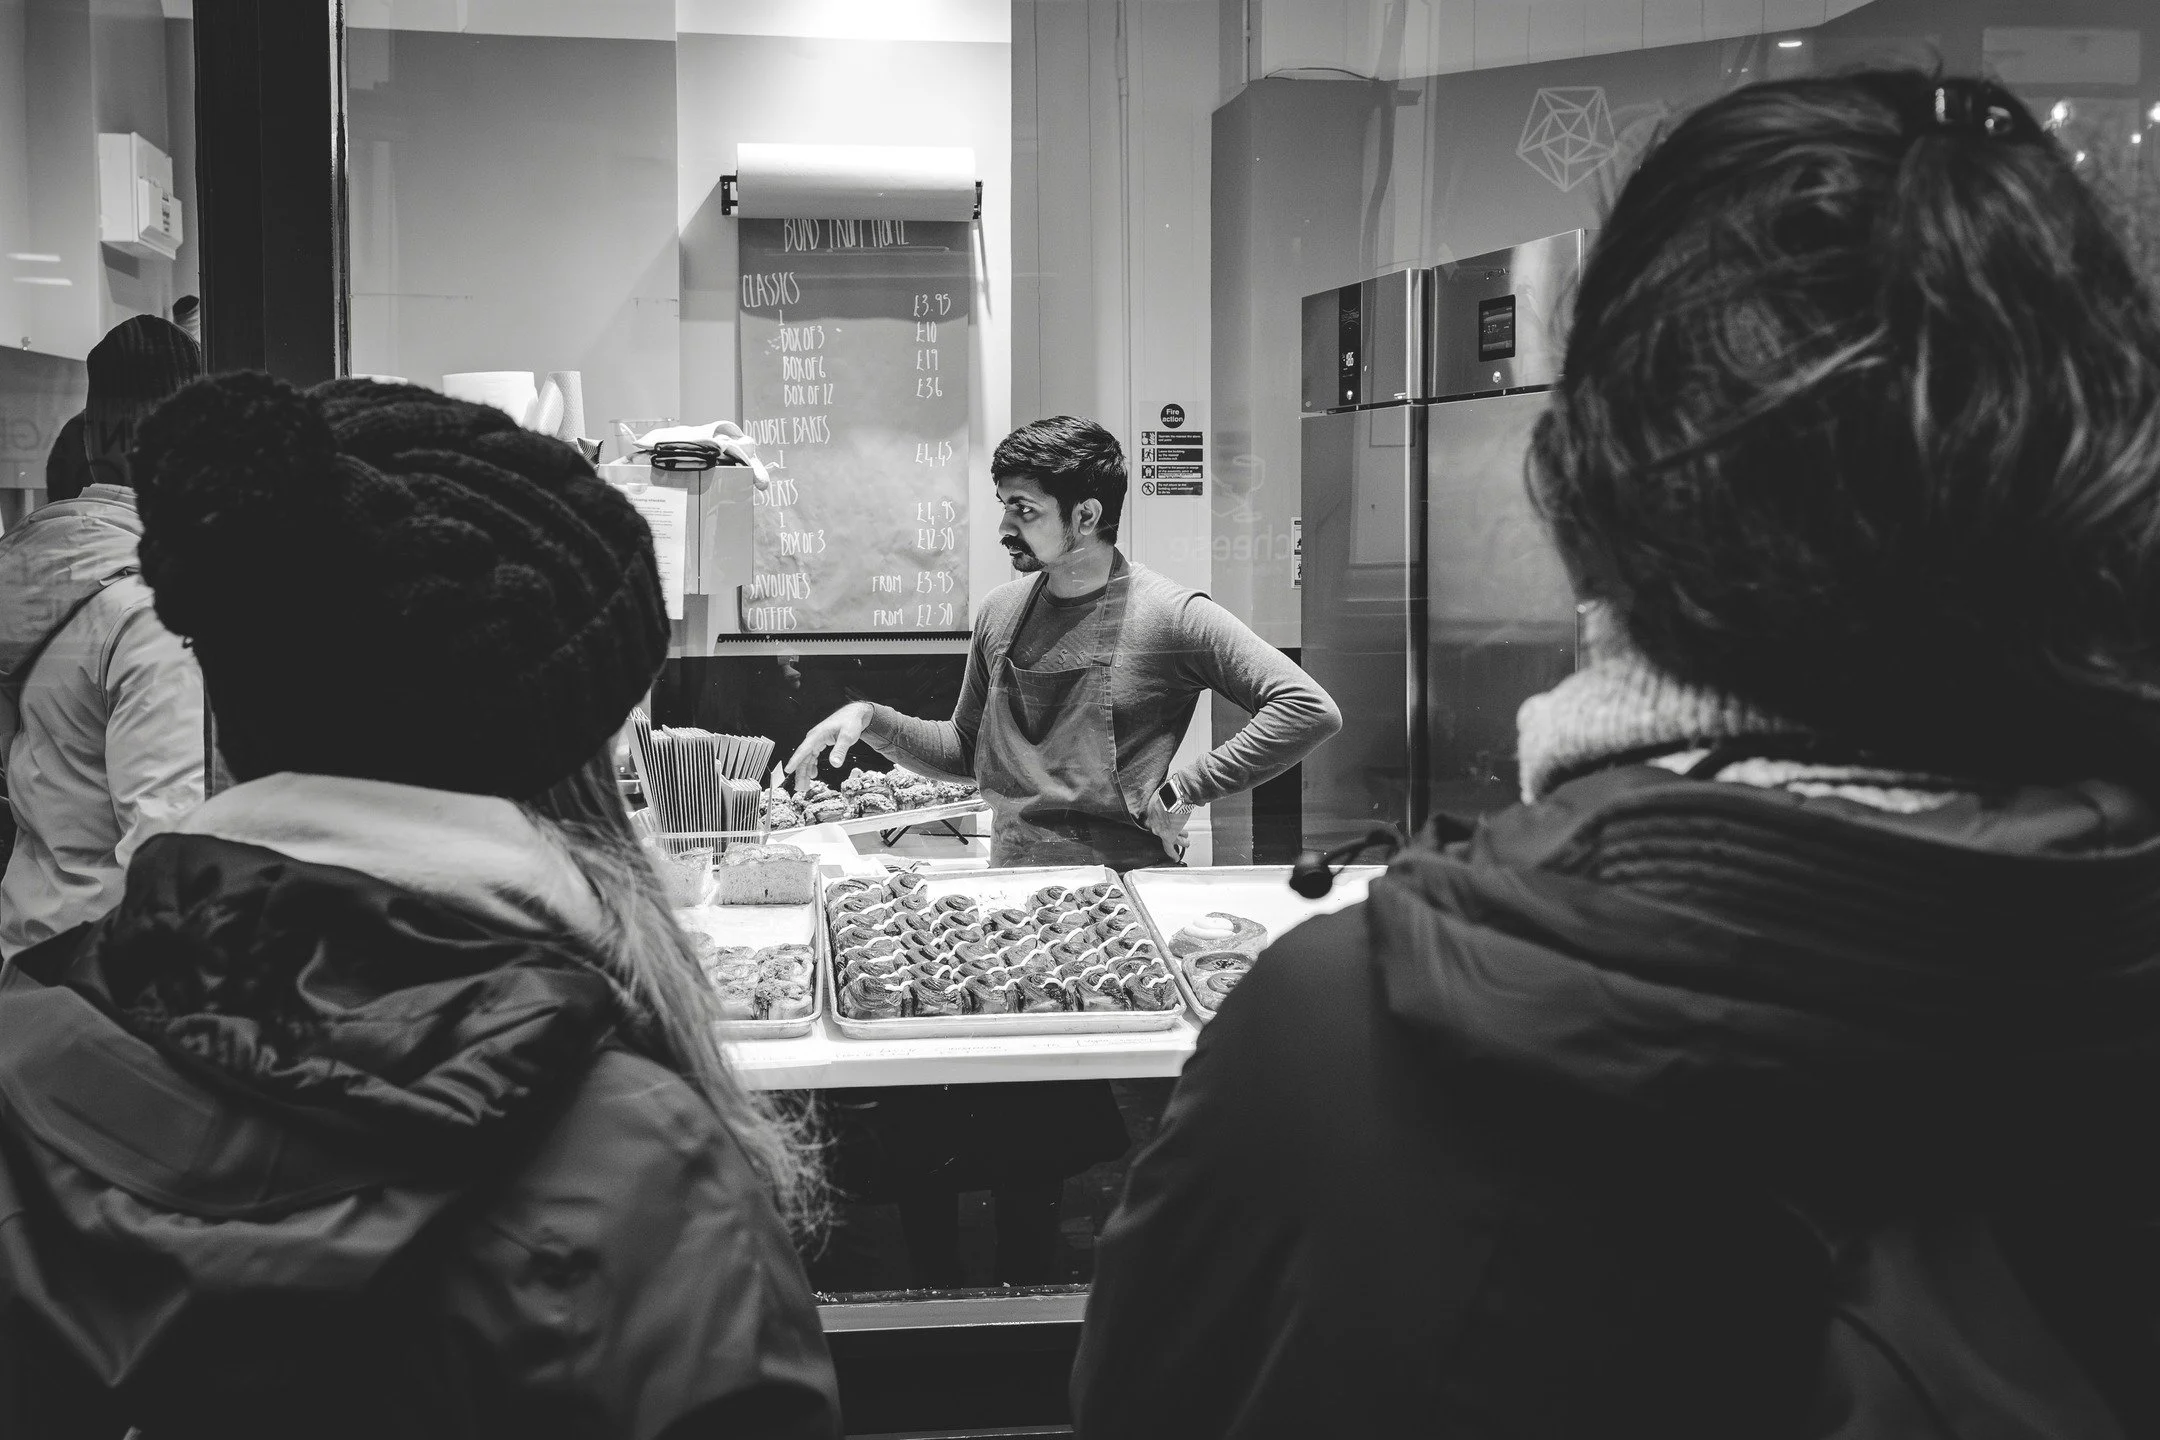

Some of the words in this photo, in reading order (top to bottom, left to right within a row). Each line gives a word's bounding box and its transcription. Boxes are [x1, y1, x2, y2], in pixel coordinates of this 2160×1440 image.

[742, 271, 800, 307] CLASSICS
[913, 293, 951, 317] £3.95
[780, 328, 802, 352] BOX
[803, 325, 816, 351] OF
[816, 325, 824, 349] 3
[915, 321, 937, 342] £10
[783, 356, 805, 382] BOX
[805, 357, 818, 380] OF
[818, 355, 826, 378] 6
[917, 349, 938, 371] £19
[784, 384, 806, 407] BOX
[807, 385, 820, 405] OF
[823, 383, 834, 405] 12
[916, 377, 943, 399] £36
[1166, 408, 1180, 416] Fire
[744, 418, 790, 446] DOUBLE
[792, 415, 830, 444] BAKES
[915, 441, 952, 467] £4.45
[753, 479, 798, 507] ESSERTS
[916, 501, 955, 525] £4.95
[780, 530, 801, 556] BOX
[802, 532, 814, 553] OF
[817, 529, 826, 553] 3
[749, 572, 811, 601] SAVOURIES
[872, 574, 902, 594] FROM
[916, 571, 954, 594] £3.95
[747, 606, 797, 631] COFFEES
[873, 607, 904, 627] FROM
